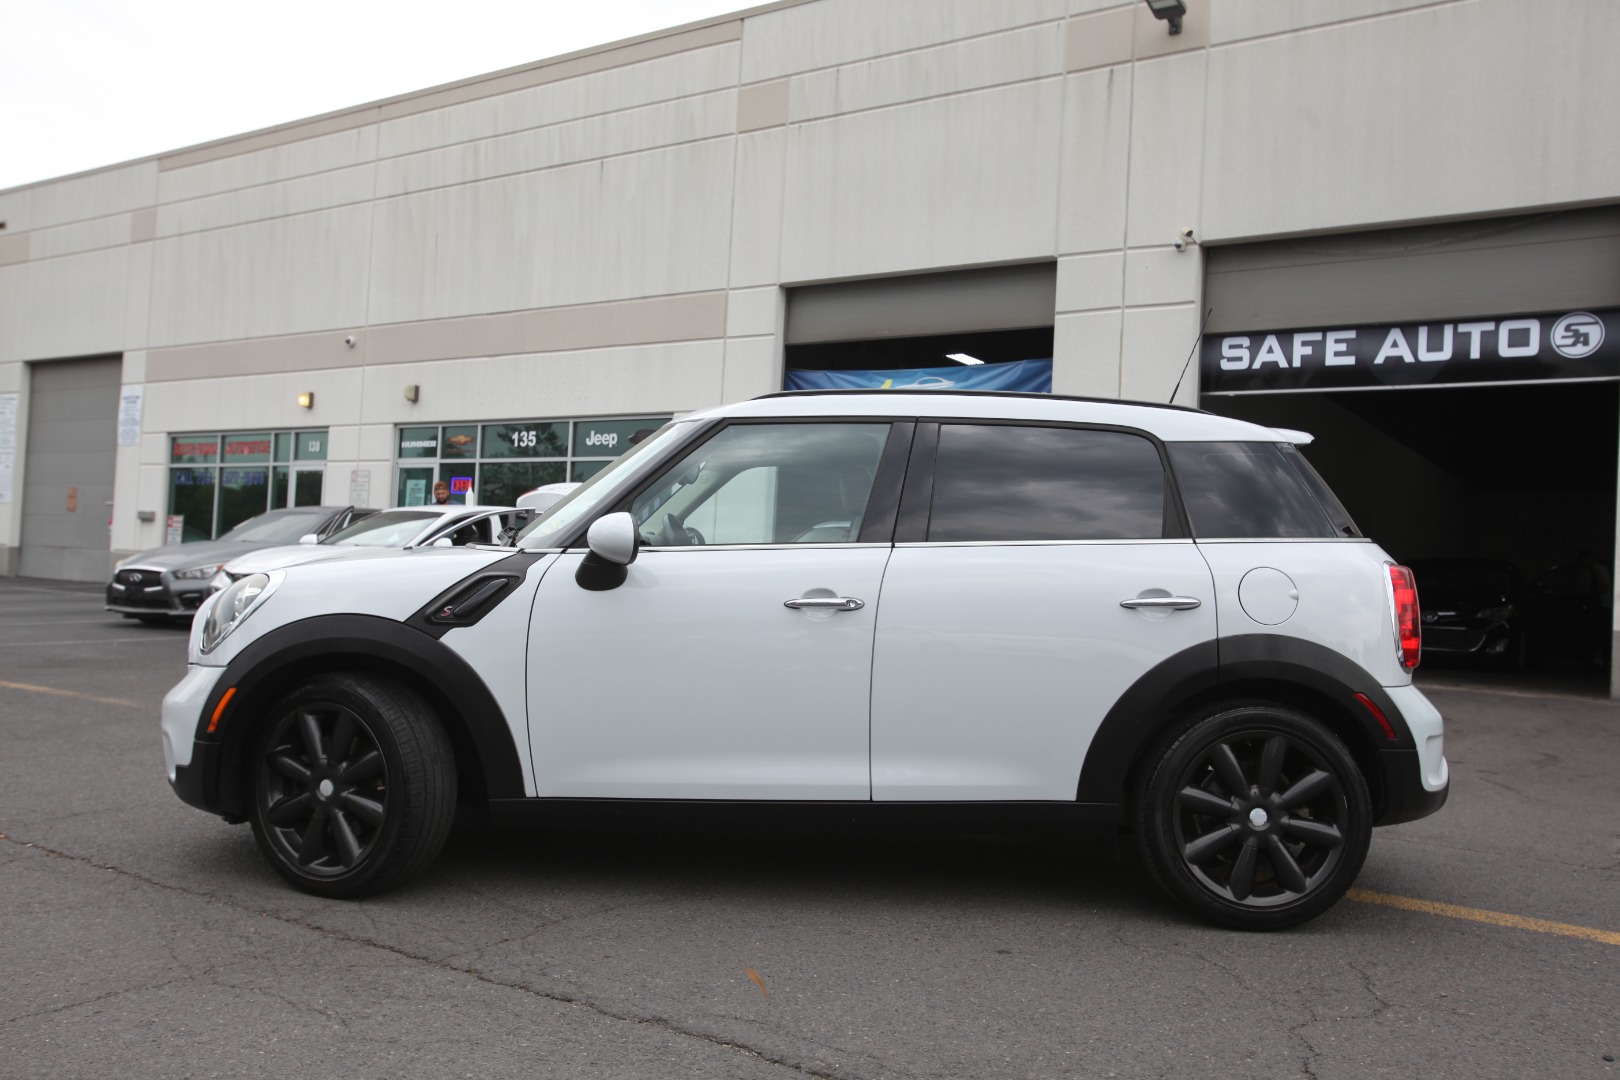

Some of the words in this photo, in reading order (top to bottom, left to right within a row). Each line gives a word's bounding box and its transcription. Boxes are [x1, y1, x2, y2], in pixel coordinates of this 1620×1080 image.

[1219, 329, 1357, 371] SAFE
[1373, 318, 1541, 365] AUTO
[308, 440, 321, 452] 130
[401, 440, 437, 448] HUMMER
[511, 430, 537, 448] 135
[585, 430, 618, 448] Jeep
[440, 605, 453, 617] S
